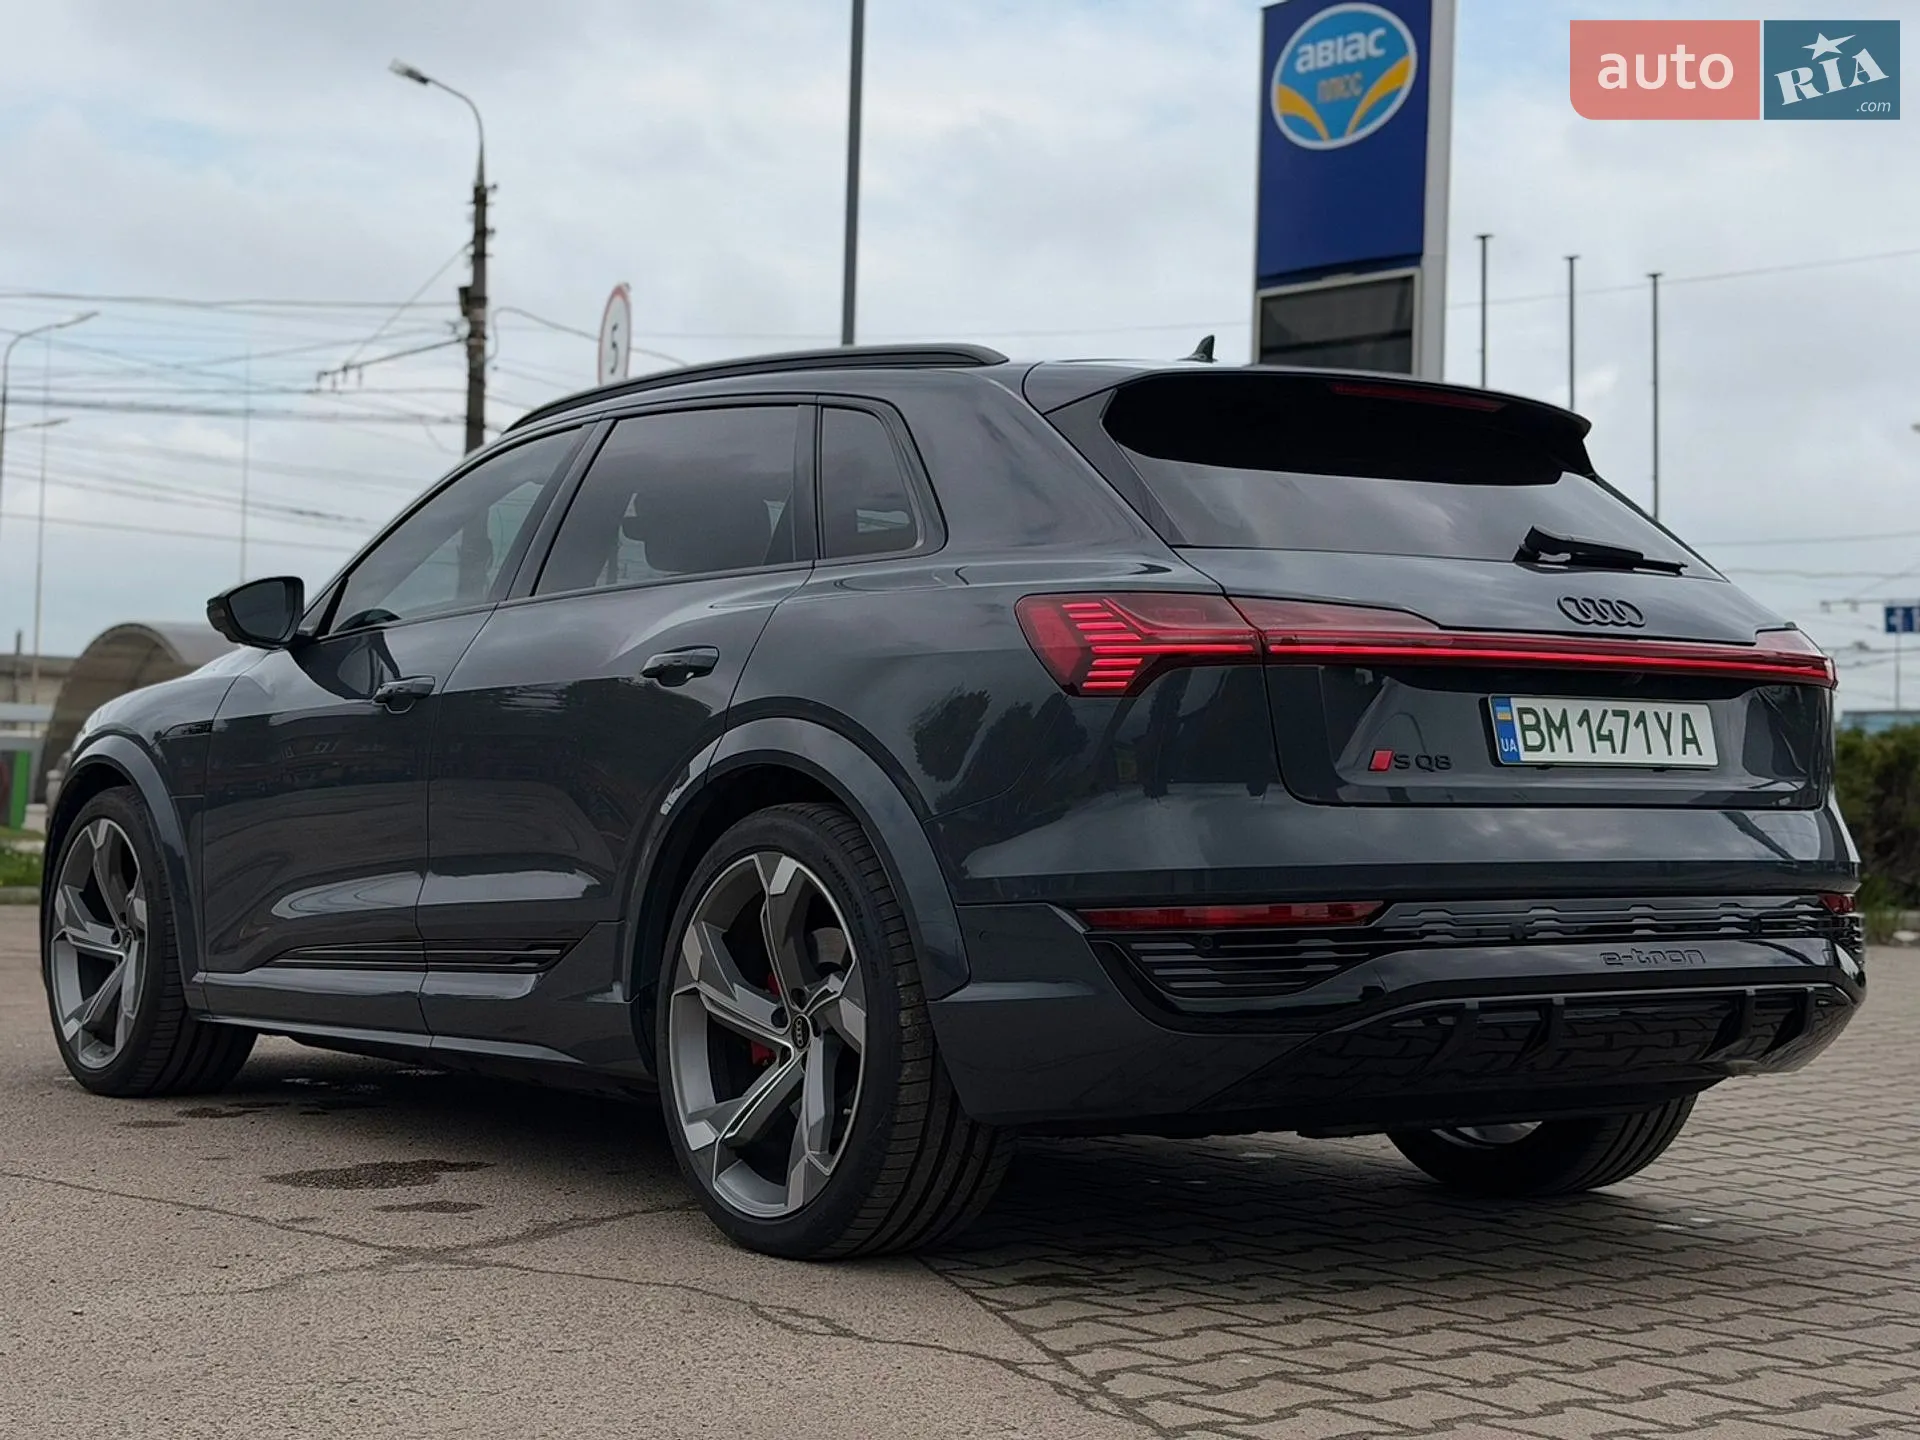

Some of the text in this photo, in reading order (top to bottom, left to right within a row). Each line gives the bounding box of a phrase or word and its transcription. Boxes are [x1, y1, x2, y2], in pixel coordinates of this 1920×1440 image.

[610, 323, 619, 375] 5
[1501, 737, 1518, 752] UA
[1600, 948, 1706, 967] e-tron
